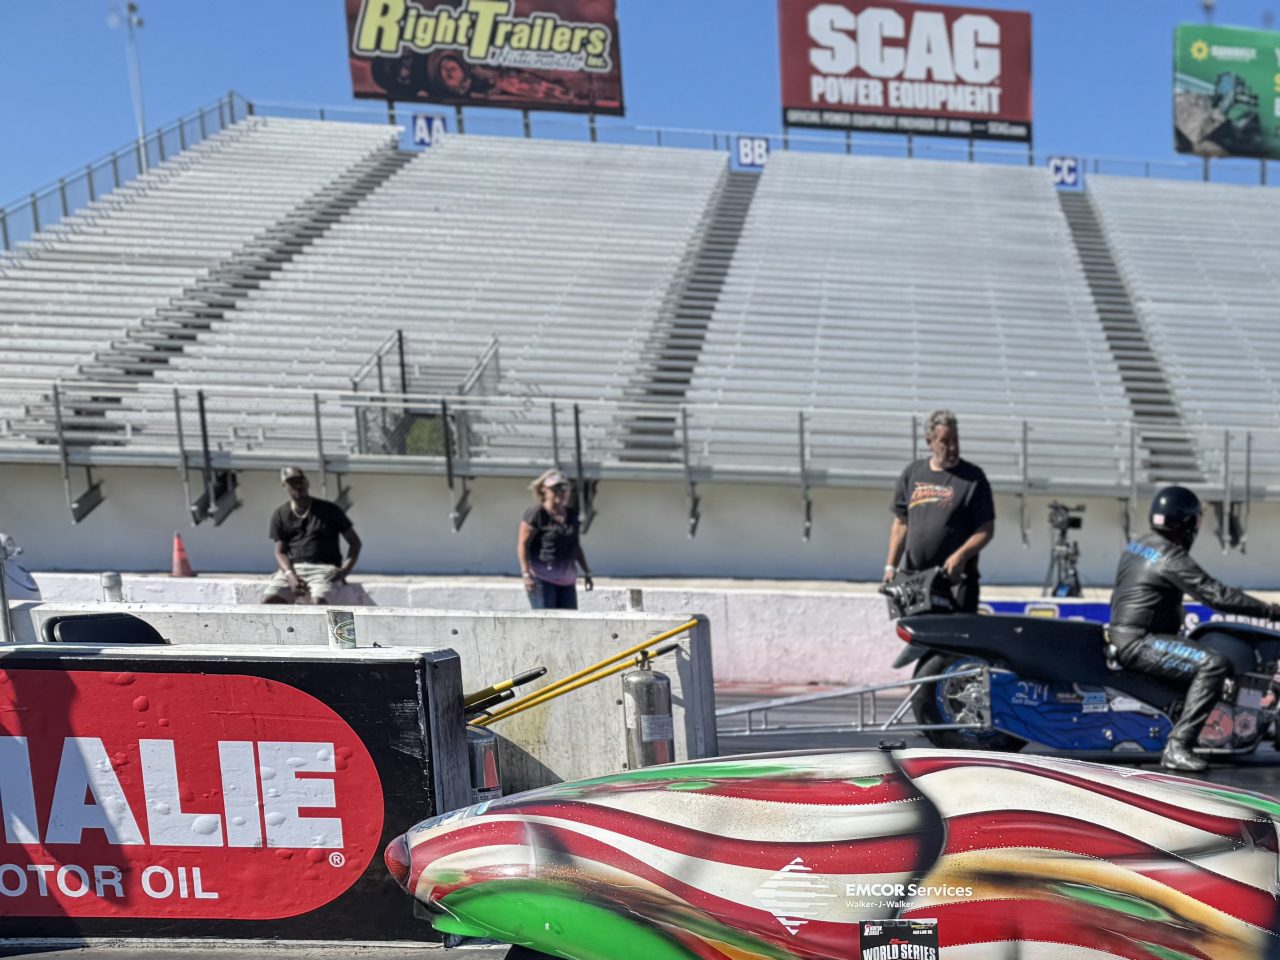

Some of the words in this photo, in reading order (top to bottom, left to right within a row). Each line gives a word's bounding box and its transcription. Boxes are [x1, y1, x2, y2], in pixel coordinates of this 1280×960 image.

[807, 3, 1000, 84] SCAG
[810, 76, 884, 107] POWER
[888, 80, 1001, 114] EQUIPMENT
[413, 116, 447, 146] AA
[739, 138, 768, 165] BB
[1049, 159, 1077, 184] CC
[142, 866, 219, 899] OIL
[846, 884, 905, 897] EMCOR
[908, 883, 973, 897] Services
[846, 900, 915, 909] Walker-J-Walker
